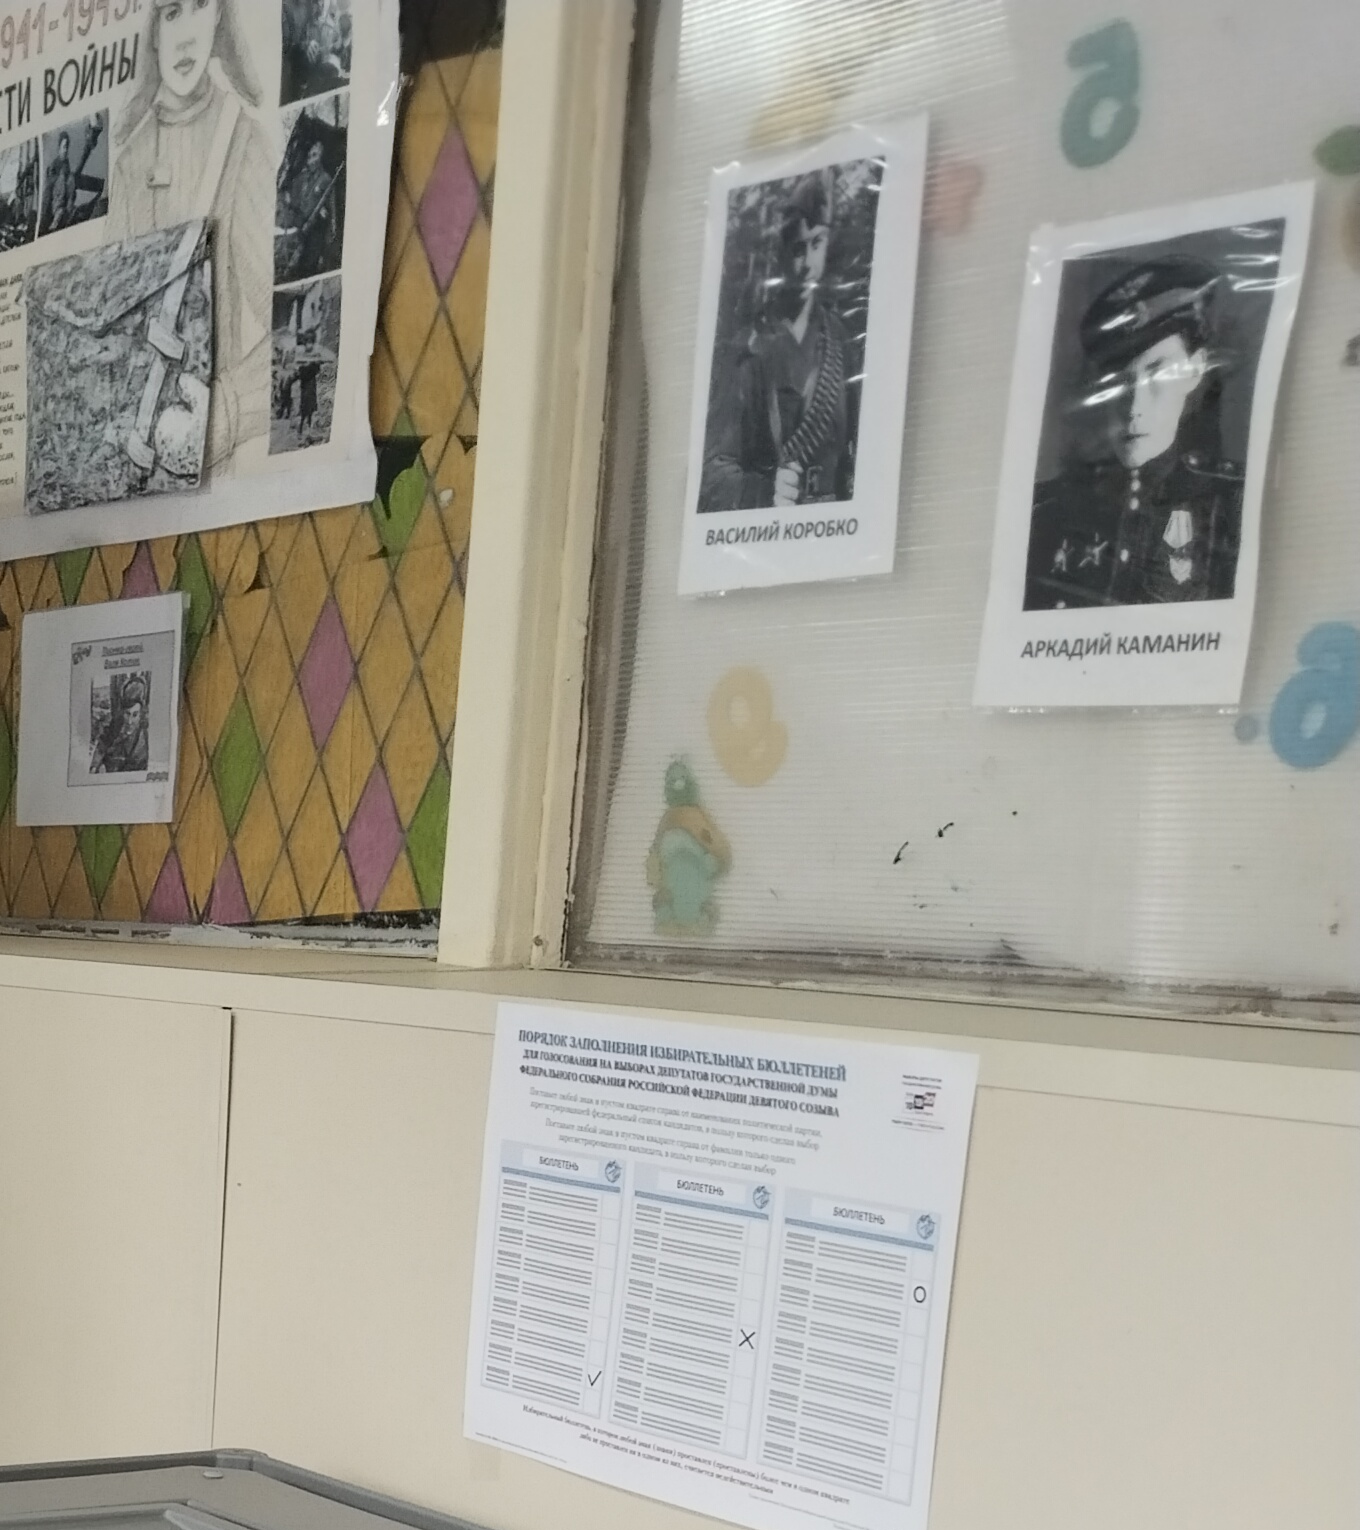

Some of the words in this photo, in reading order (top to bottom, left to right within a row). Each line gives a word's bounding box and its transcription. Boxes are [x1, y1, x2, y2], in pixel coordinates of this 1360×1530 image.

[43, 32, 140, 116] ВОЙНЫ
[705, 520, 780, 546] ВАСИЛИЙ
[783, 518, 859, 541] КОРОБКО
[1020, 632, 1112, 661] АРКАДИЙ
[1116, 632, 1222, 655] КАМАНИН
[518, 1029, 568, 1047] ПОРЯДОК
[568, 1035, 647, 1057] ЗАПОЛНЕНИЯ
[650, 1045, 754, 1070] ИЗБИРАТЕЛЬНЫХ
[756, 1058, 846, 1081] БЮЛЛЕТЕНЕЙ
[539, 1050, 597, 1067] ГОЛОСОВАНИЯ
[599, 1058, 612, 1069] НА
[614, 1060, 655, 1075] ВЫБОРАХ
[656, 1065, 709, 1082] ДЕПУТАТОВ
[710, 1072, 805, 1094] ГОСУДАРСТВЕННОЙ
[806, 1085, 837, 1099] ДУМЫ
[519, 1064, 578, 1081] ФЕДЕРАЛЬНОГО
[578, 1072, 626, 1088] СОБРАНИЯ
[627, 1079, 690, 1096] РОССИЙСКОЙ
[690, 1087, 747, 1105] ФЕДЕРАЦИИ
[748, 1095, 797, 1112] ДЕВЯТОГО
[798, 1102, 839, 1117] СОЗЫВА
[538, 1155, 579, 1171] БЮЛЛЕТЕНЬ
[676, 1178, 724, 1196] БЮЛЛЕТЕНЬ
[832, 1206, 886, 1225] БЮЛЛЕТЕНЬ
